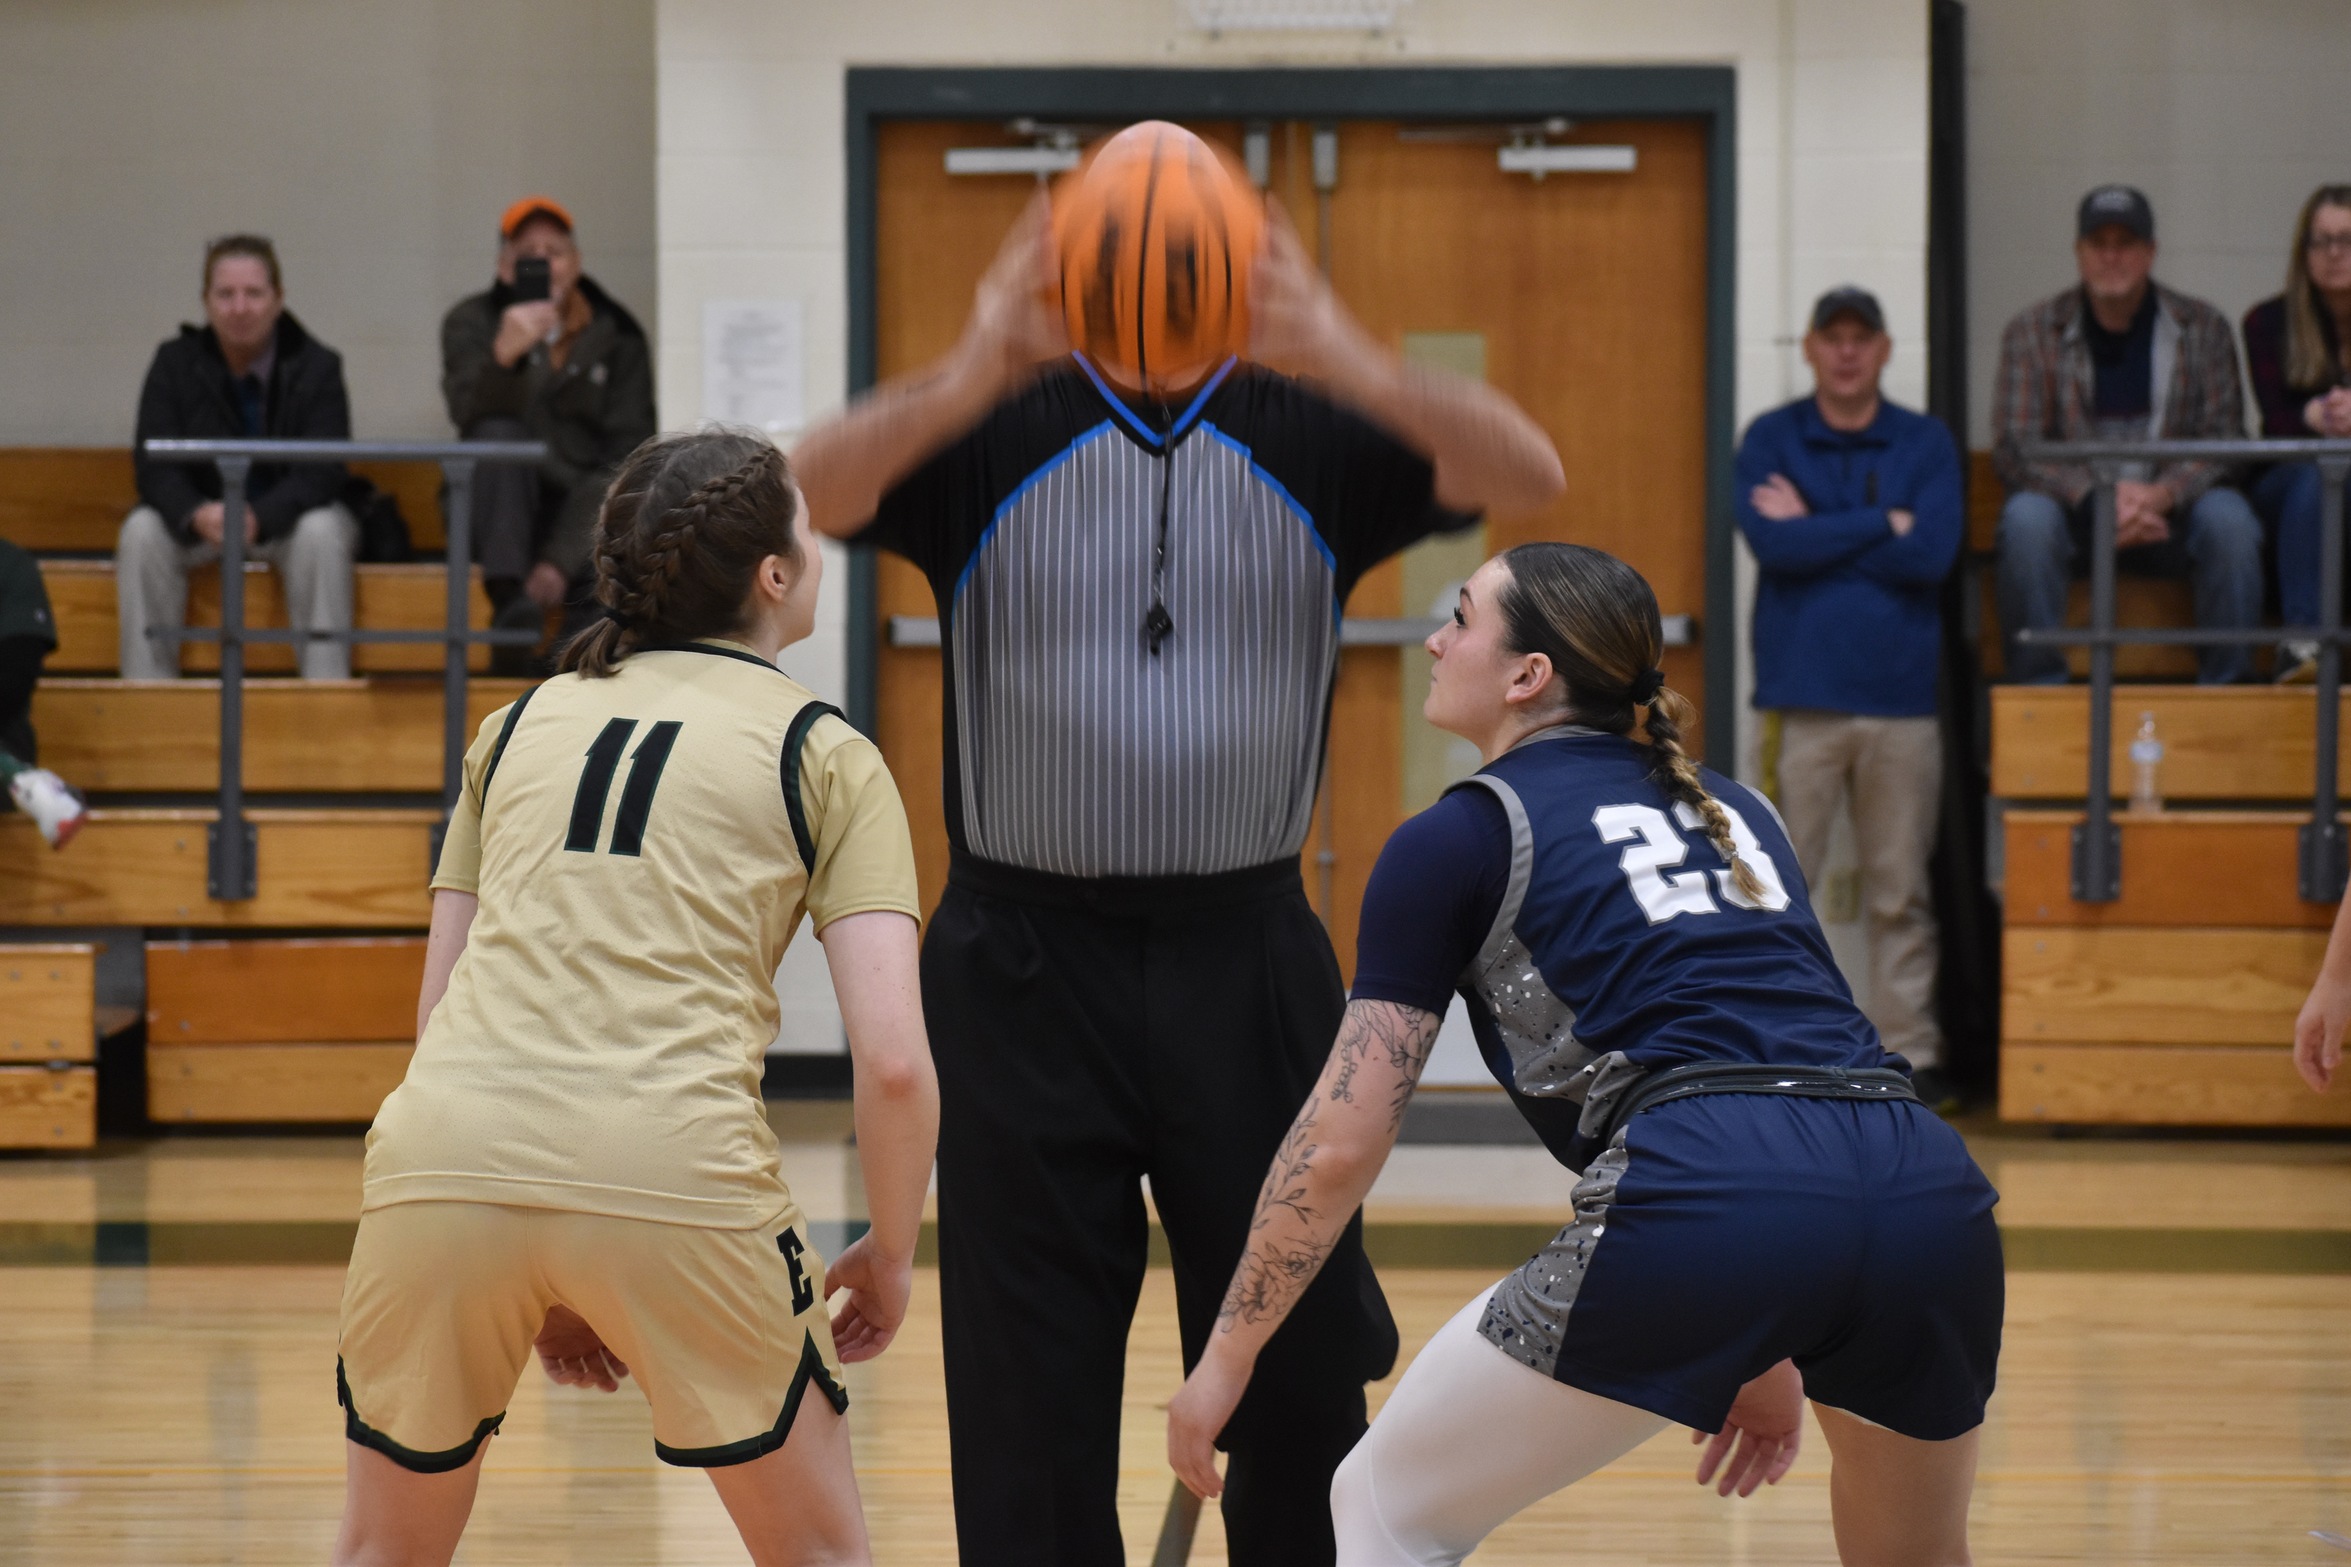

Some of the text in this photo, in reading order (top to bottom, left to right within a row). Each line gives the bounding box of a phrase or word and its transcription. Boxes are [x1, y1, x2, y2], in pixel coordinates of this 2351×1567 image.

[564, 717, 682, 856] 11
[1591, 801, 1791, 924] 23
[776, 1226, 814, 1316] E
